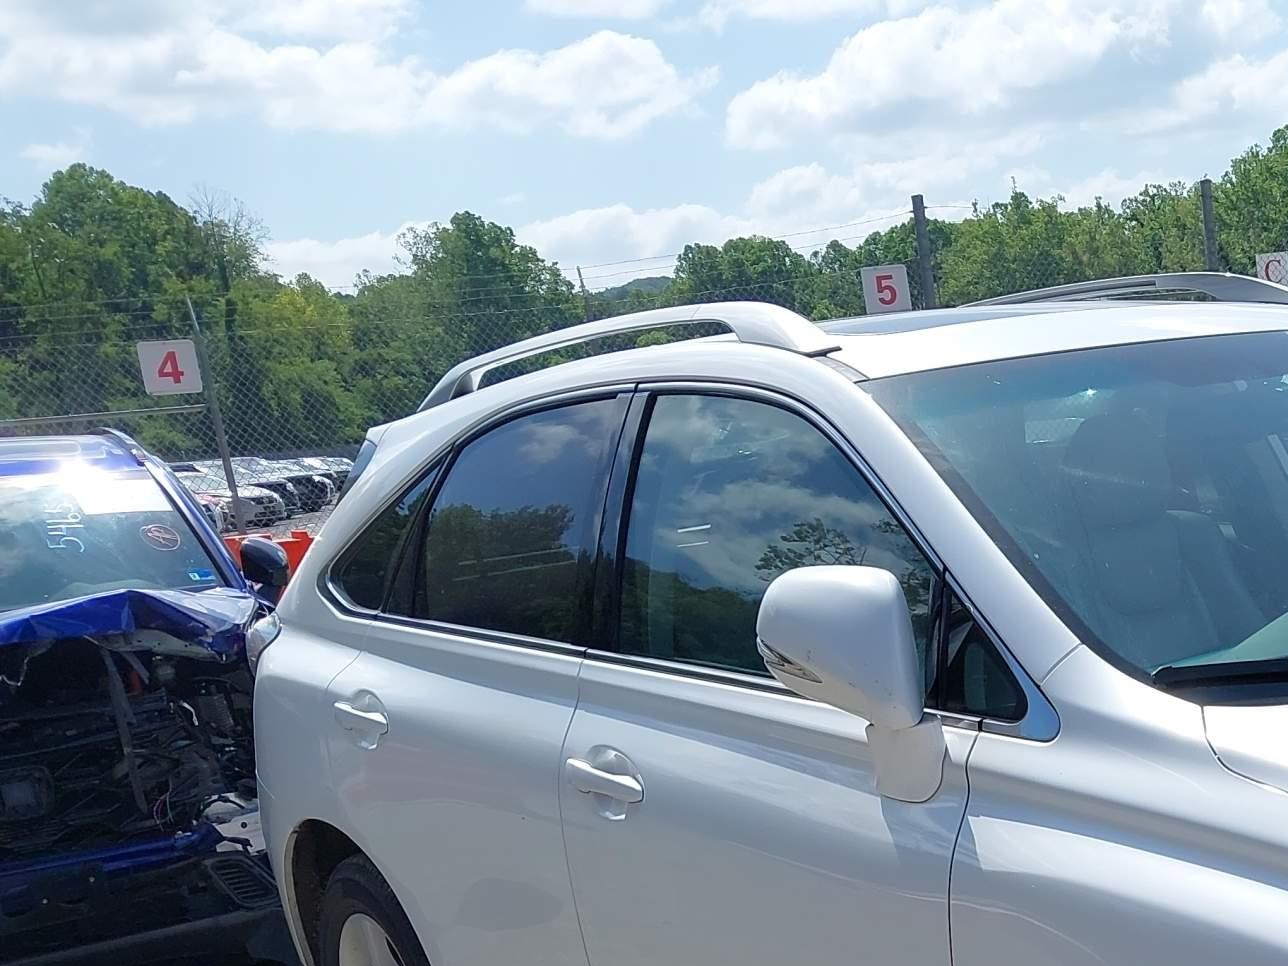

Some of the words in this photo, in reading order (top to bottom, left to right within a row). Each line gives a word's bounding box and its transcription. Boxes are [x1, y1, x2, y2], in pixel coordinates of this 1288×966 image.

[1265, 260, 1281, 283] C
[876, 275, 896, 305] 5
[158, 351, 184, 384] 4
